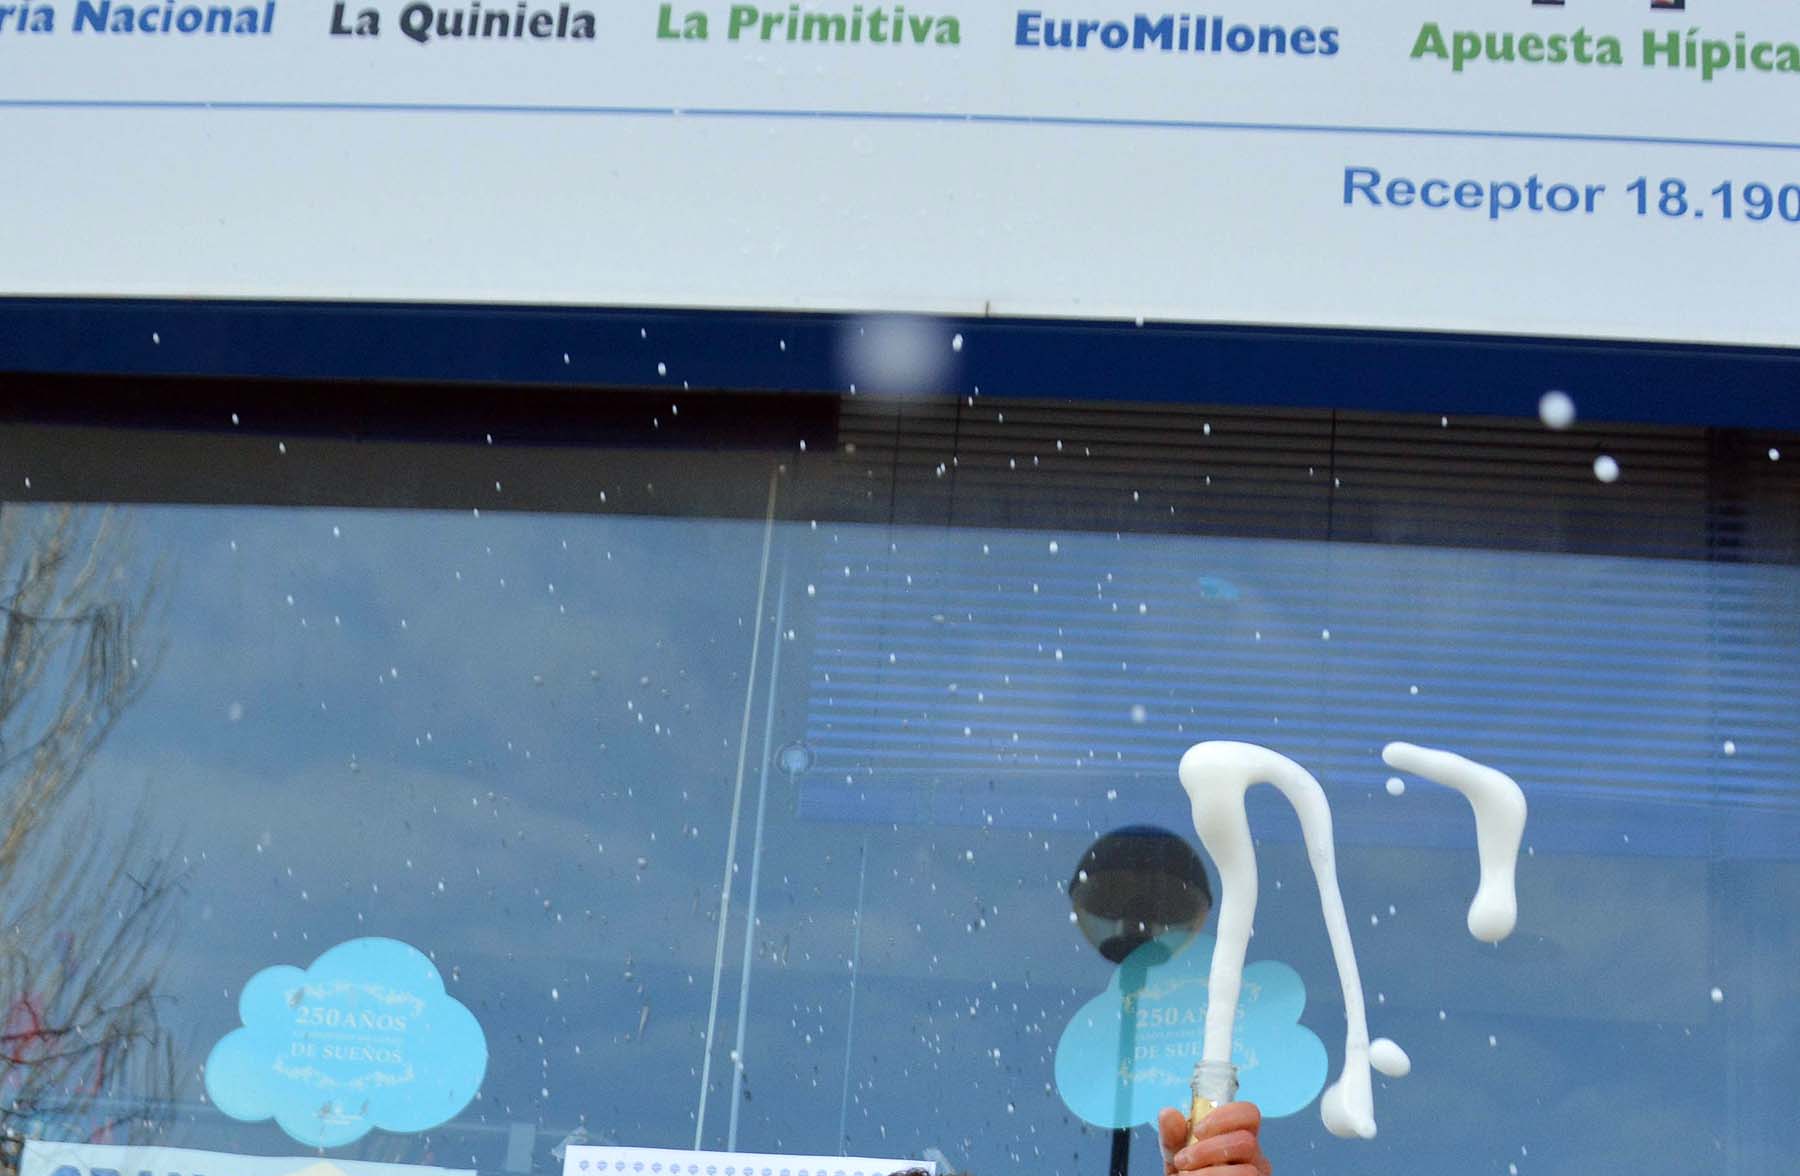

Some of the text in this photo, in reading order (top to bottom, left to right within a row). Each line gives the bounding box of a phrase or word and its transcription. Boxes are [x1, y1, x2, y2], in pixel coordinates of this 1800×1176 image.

[72, 0, 275, 33] Nacional
[331, 2, 597, 43] La Quiniela
[656, 4, 961, 46] La Primitiva
[1014, 11, 1340, 56] EuroMillones
[1410, 22, 1800, 81] Apuesta Hípica
[1342, 167, 1800, 221] Receptor 18.190
[296, 1007, 406, 1031] 250 AÑOS
